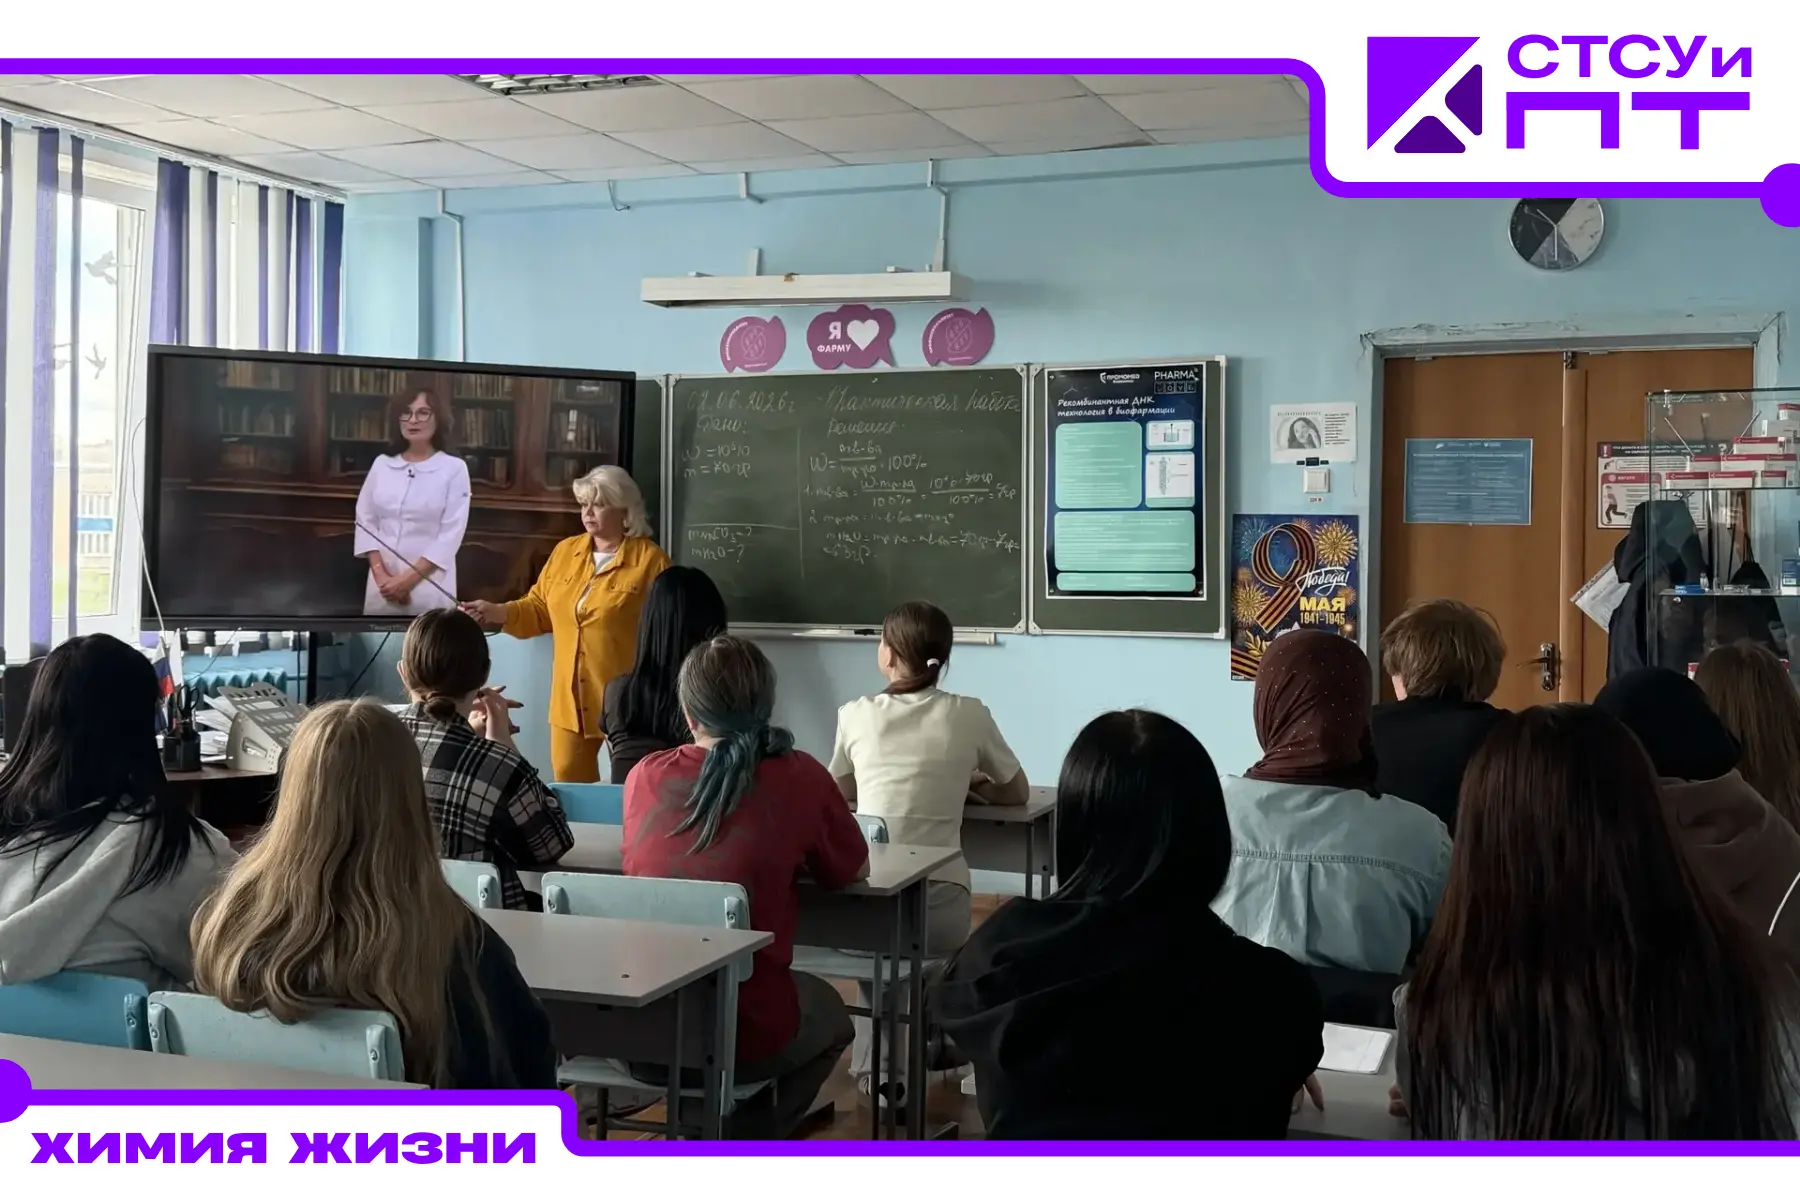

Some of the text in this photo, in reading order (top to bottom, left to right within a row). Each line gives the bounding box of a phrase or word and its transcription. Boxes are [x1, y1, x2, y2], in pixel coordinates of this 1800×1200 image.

[828, 321, 841, 340] Я
[816, 343, 852, 353] ФАРМУ
[1154, 370, 1196, 380] PHARMA
[1057, 395, 1155, 407] Рекомбинантная ДНК
[1057, 403, 1176, 417] технология в биофармации
[1300, 596, 1346, 612] МАЯ
[1300, 612, 1346, 625] 1941-1945
